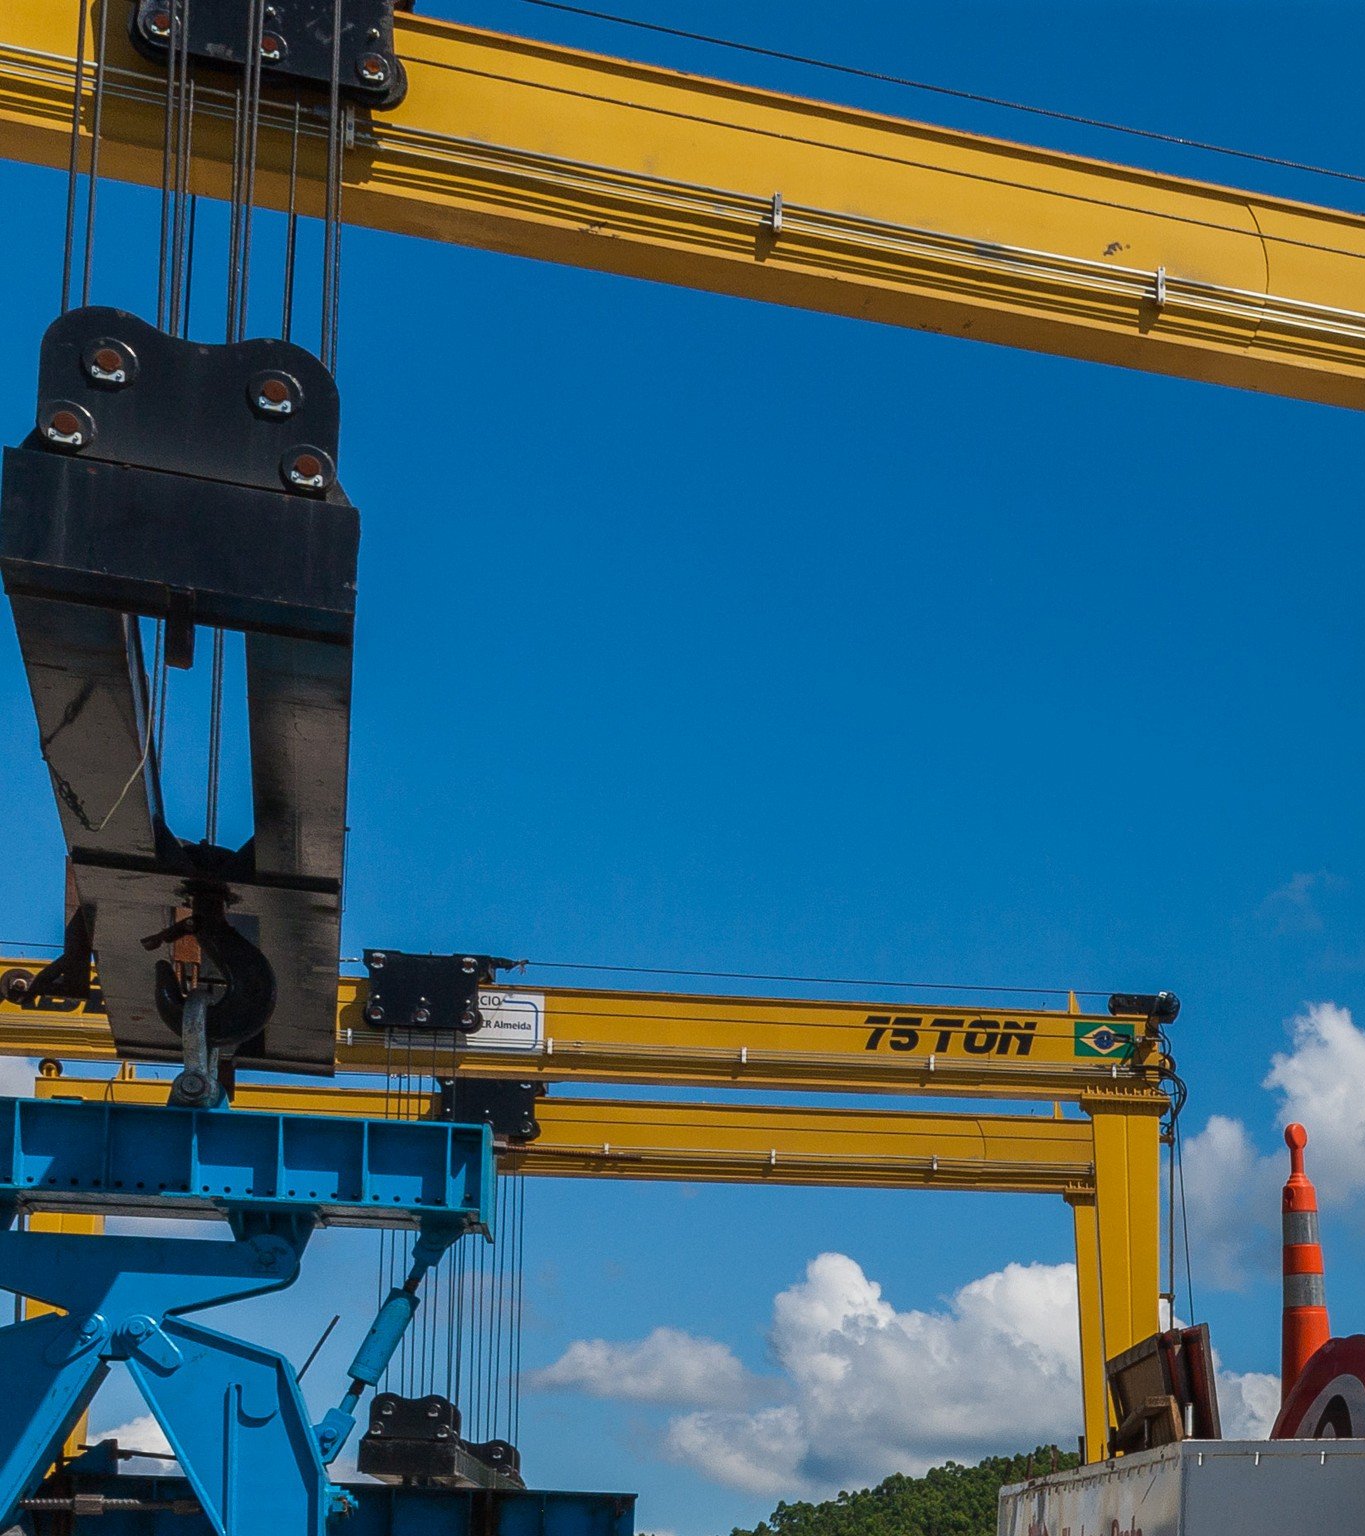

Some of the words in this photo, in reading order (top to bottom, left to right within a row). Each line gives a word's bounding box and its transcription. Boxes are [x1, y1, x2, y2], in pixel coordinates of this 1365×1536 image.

[480, 995, 501, 1006] CIO
[493, 1020, 532, 1031] Almeida
[864, 1015, 923, 1051] 75
[930, 1019, 1037, 1055] TON
